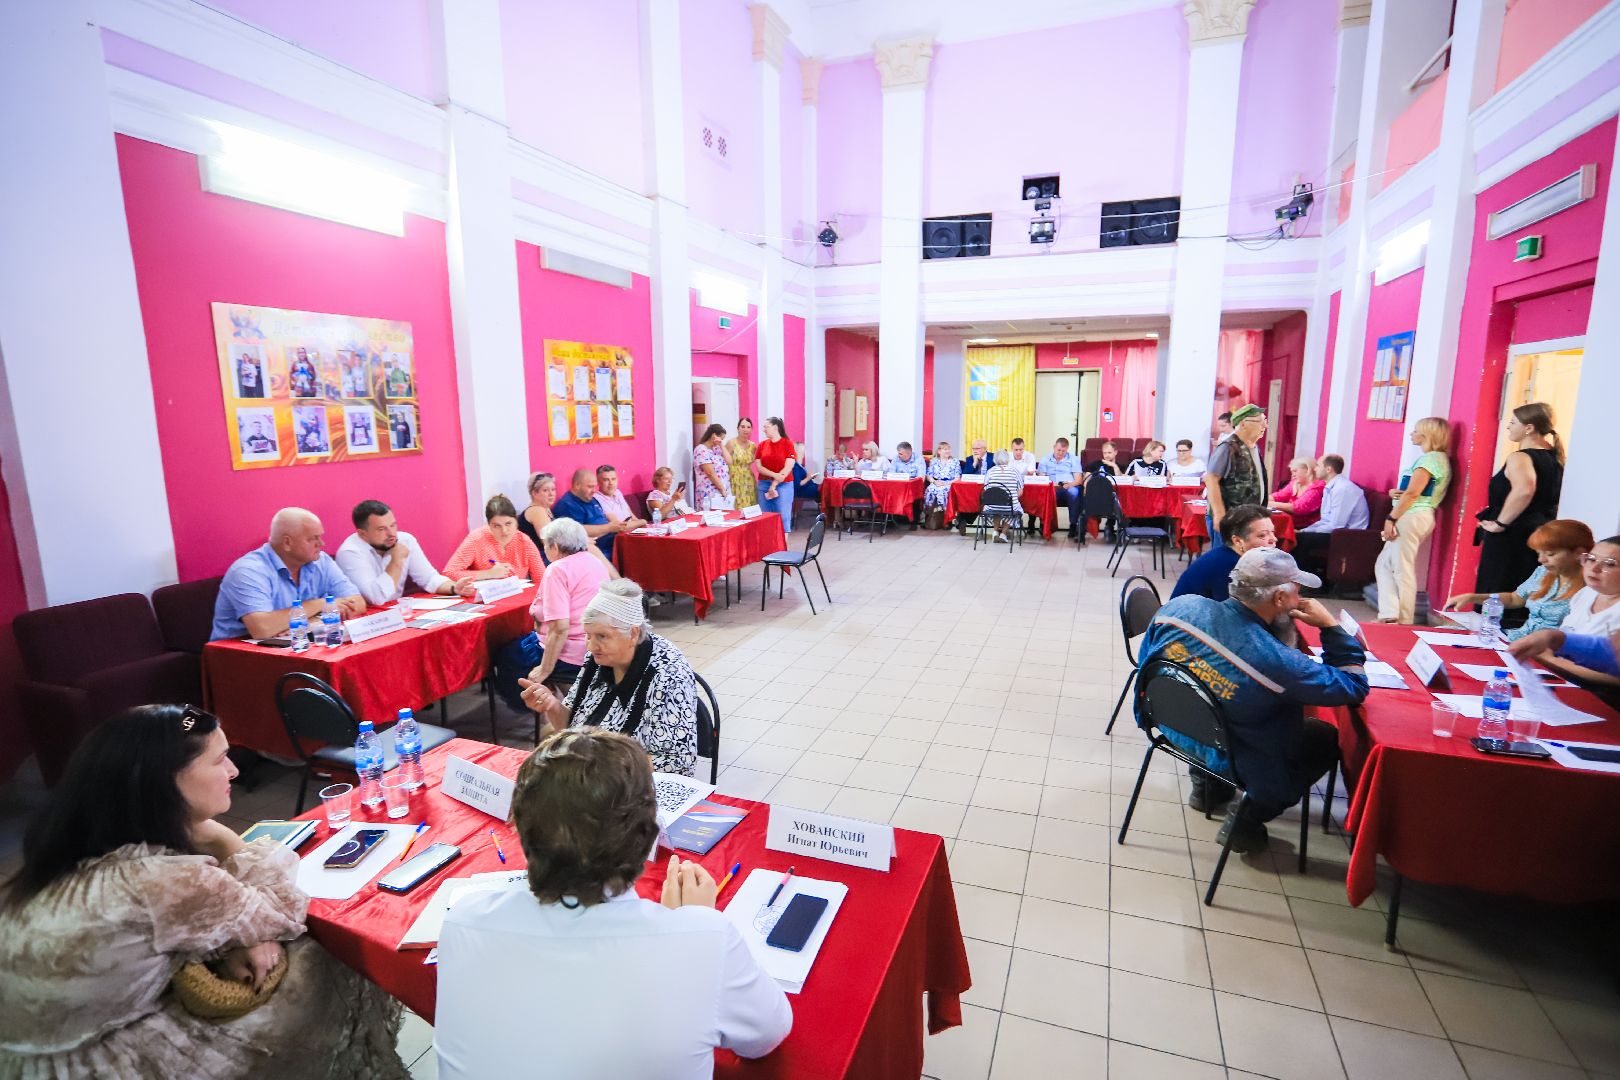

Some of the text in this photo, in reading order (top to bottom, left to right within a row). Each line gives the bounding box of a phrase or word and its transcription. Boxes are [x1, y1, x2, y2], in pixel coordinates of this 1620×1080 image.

[455, 769, 501, 797] СОЦИАЛЬНАЯ
[460, 784, 489, 806] ЗАЩИТА
[792, 820, 865, 844] ХОВАНСКИЙ
[787, 833, 868, 859] Игнат Юрьевич
